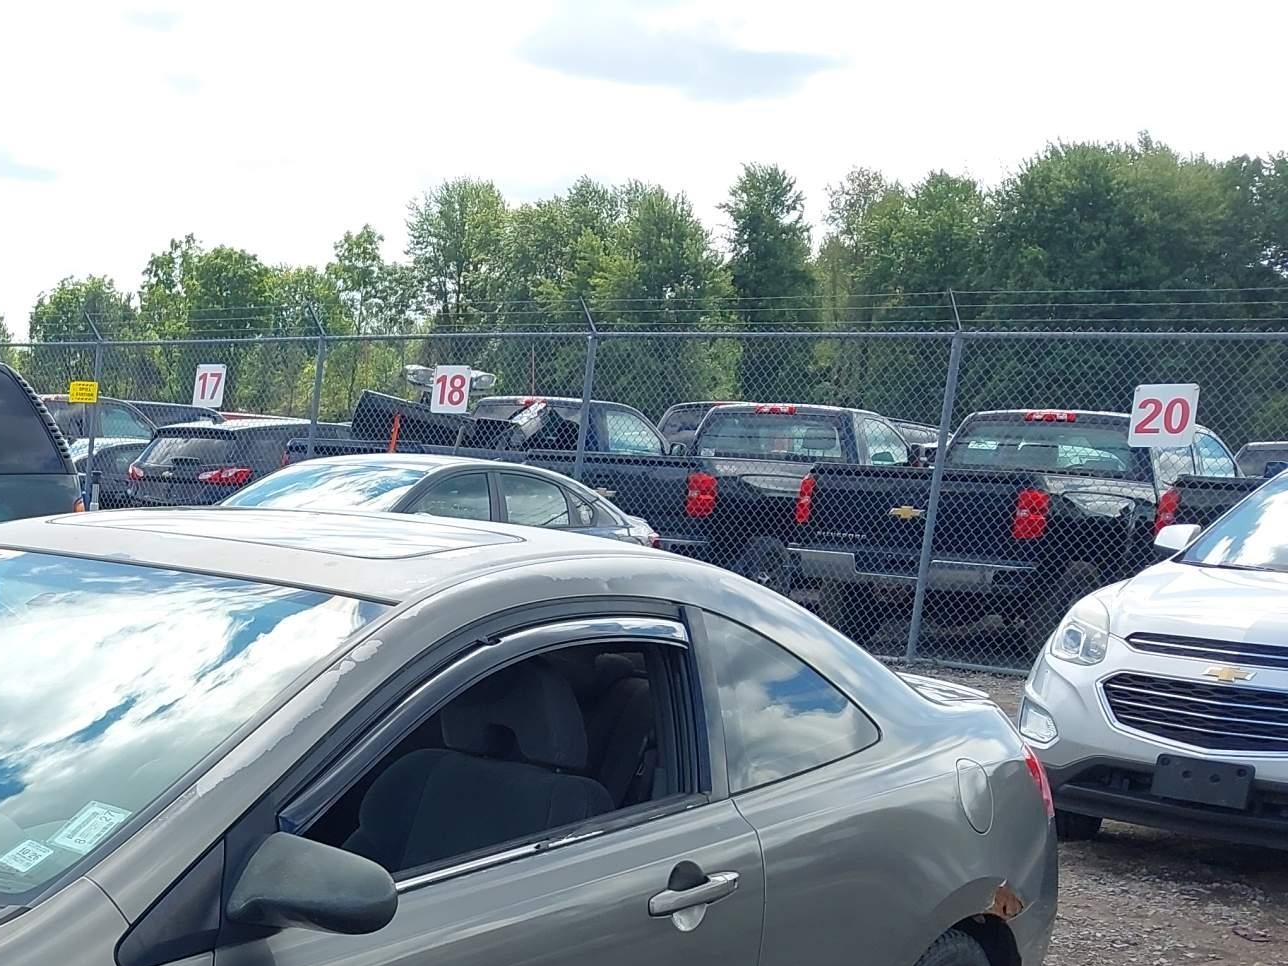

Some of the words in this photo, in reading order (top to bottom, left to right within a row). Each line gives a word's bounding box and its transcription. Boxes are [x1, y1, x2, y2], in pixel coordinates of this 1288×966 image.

[197, 372, 223, 401] 17
[435, 373, 467, 406] 18
[1134, 397, 1191, 435] 20
